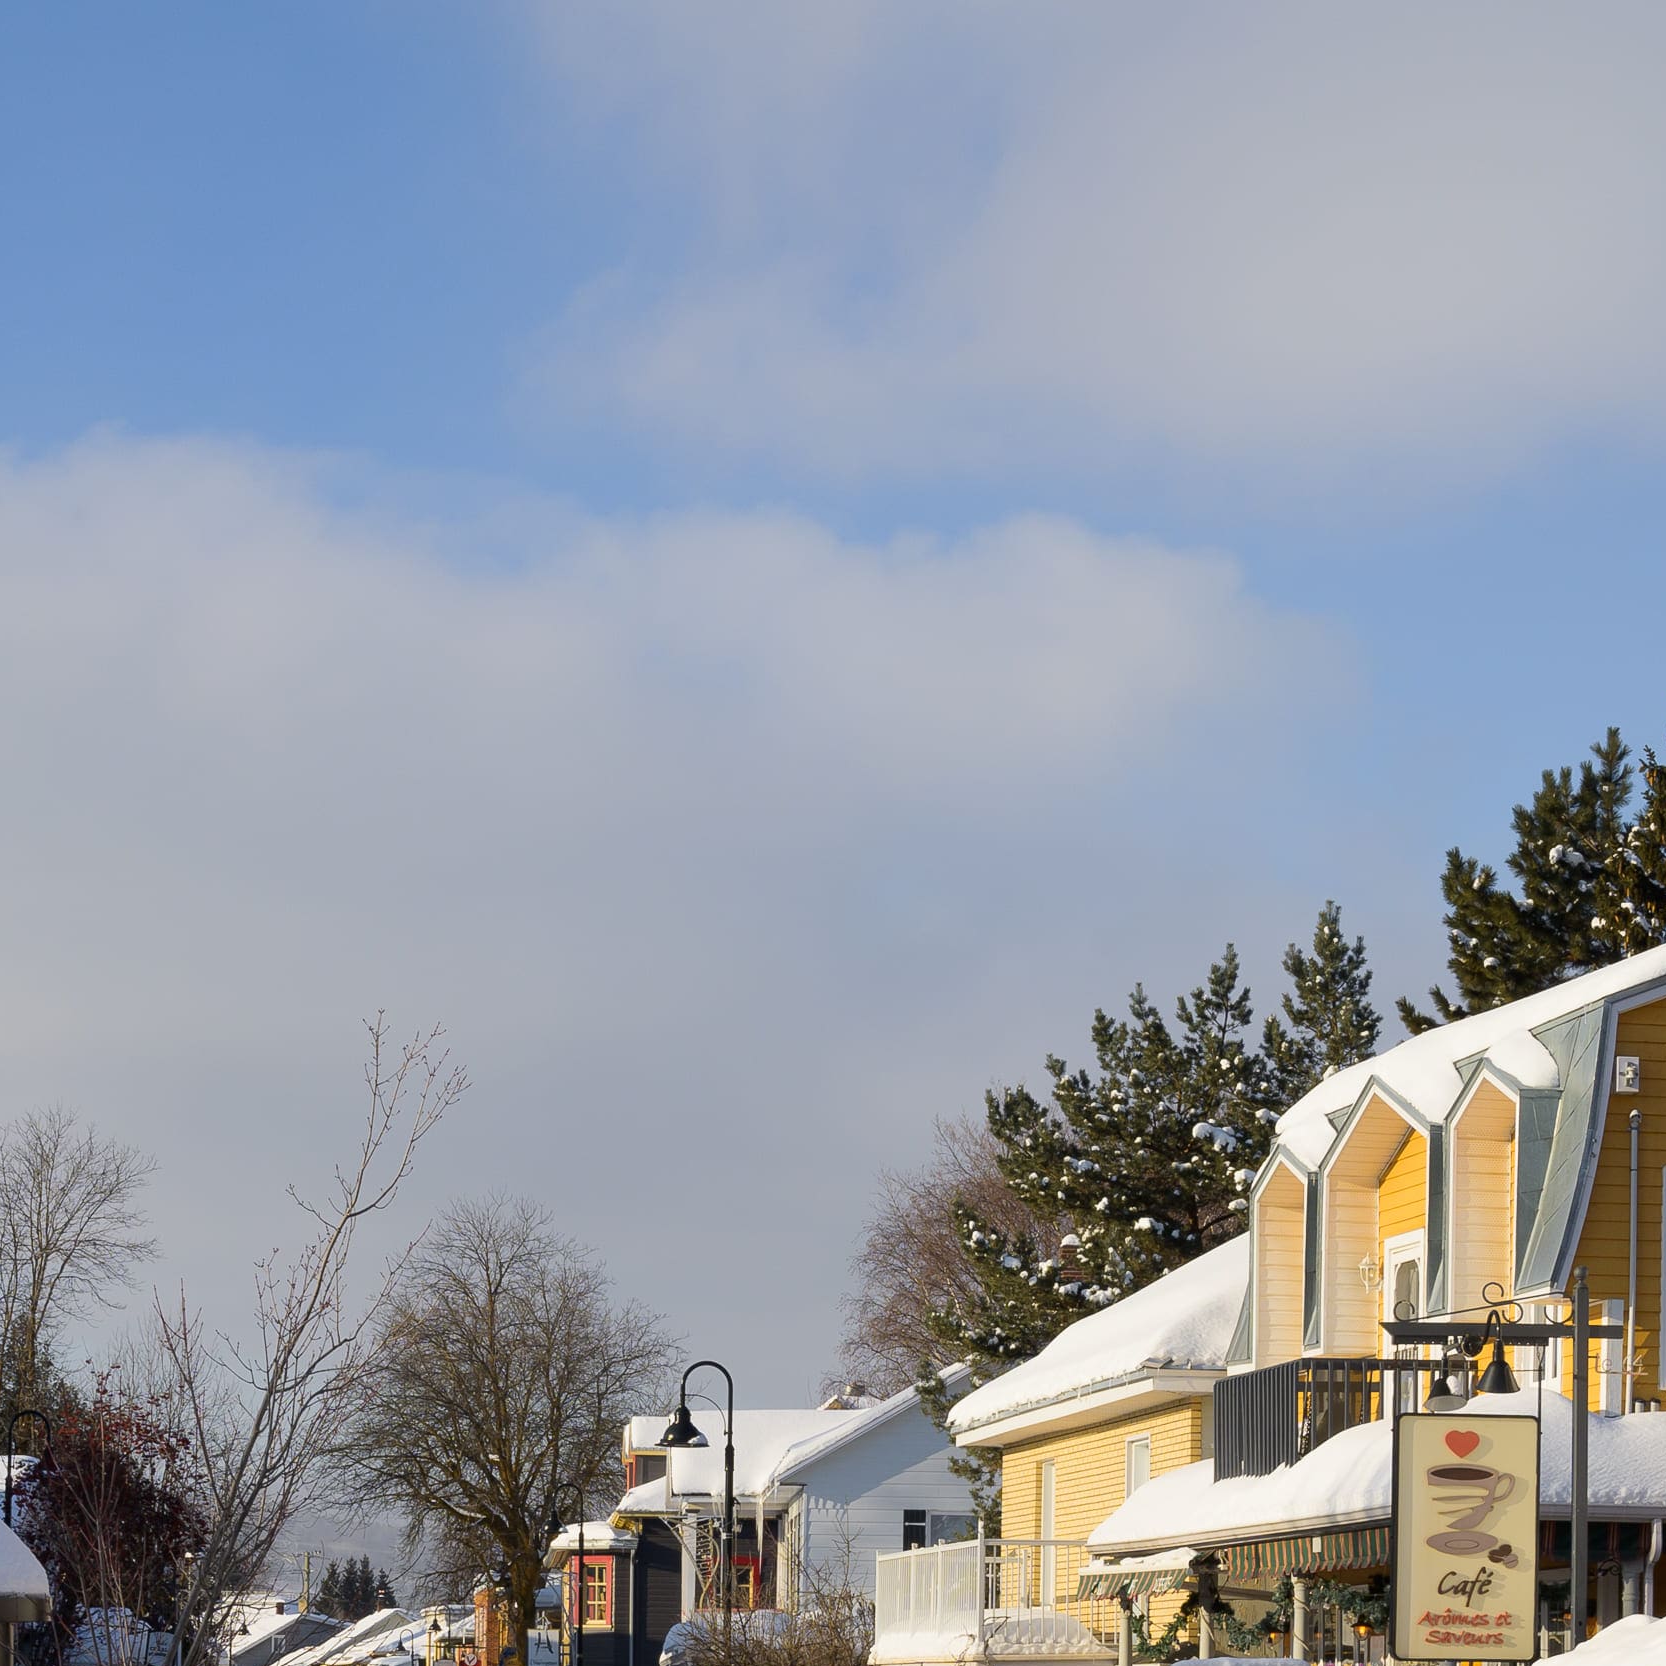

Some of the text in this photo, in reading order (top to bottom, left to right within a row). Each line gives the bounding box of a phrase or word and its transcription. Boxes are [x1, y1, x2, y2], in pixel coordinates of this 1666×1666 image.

[1437, 1566, 1494, 1607] Café
[1417, 1608, 1513, 1627] Arômes et
[1424, 1629, 1505, 1646] Saveurs
